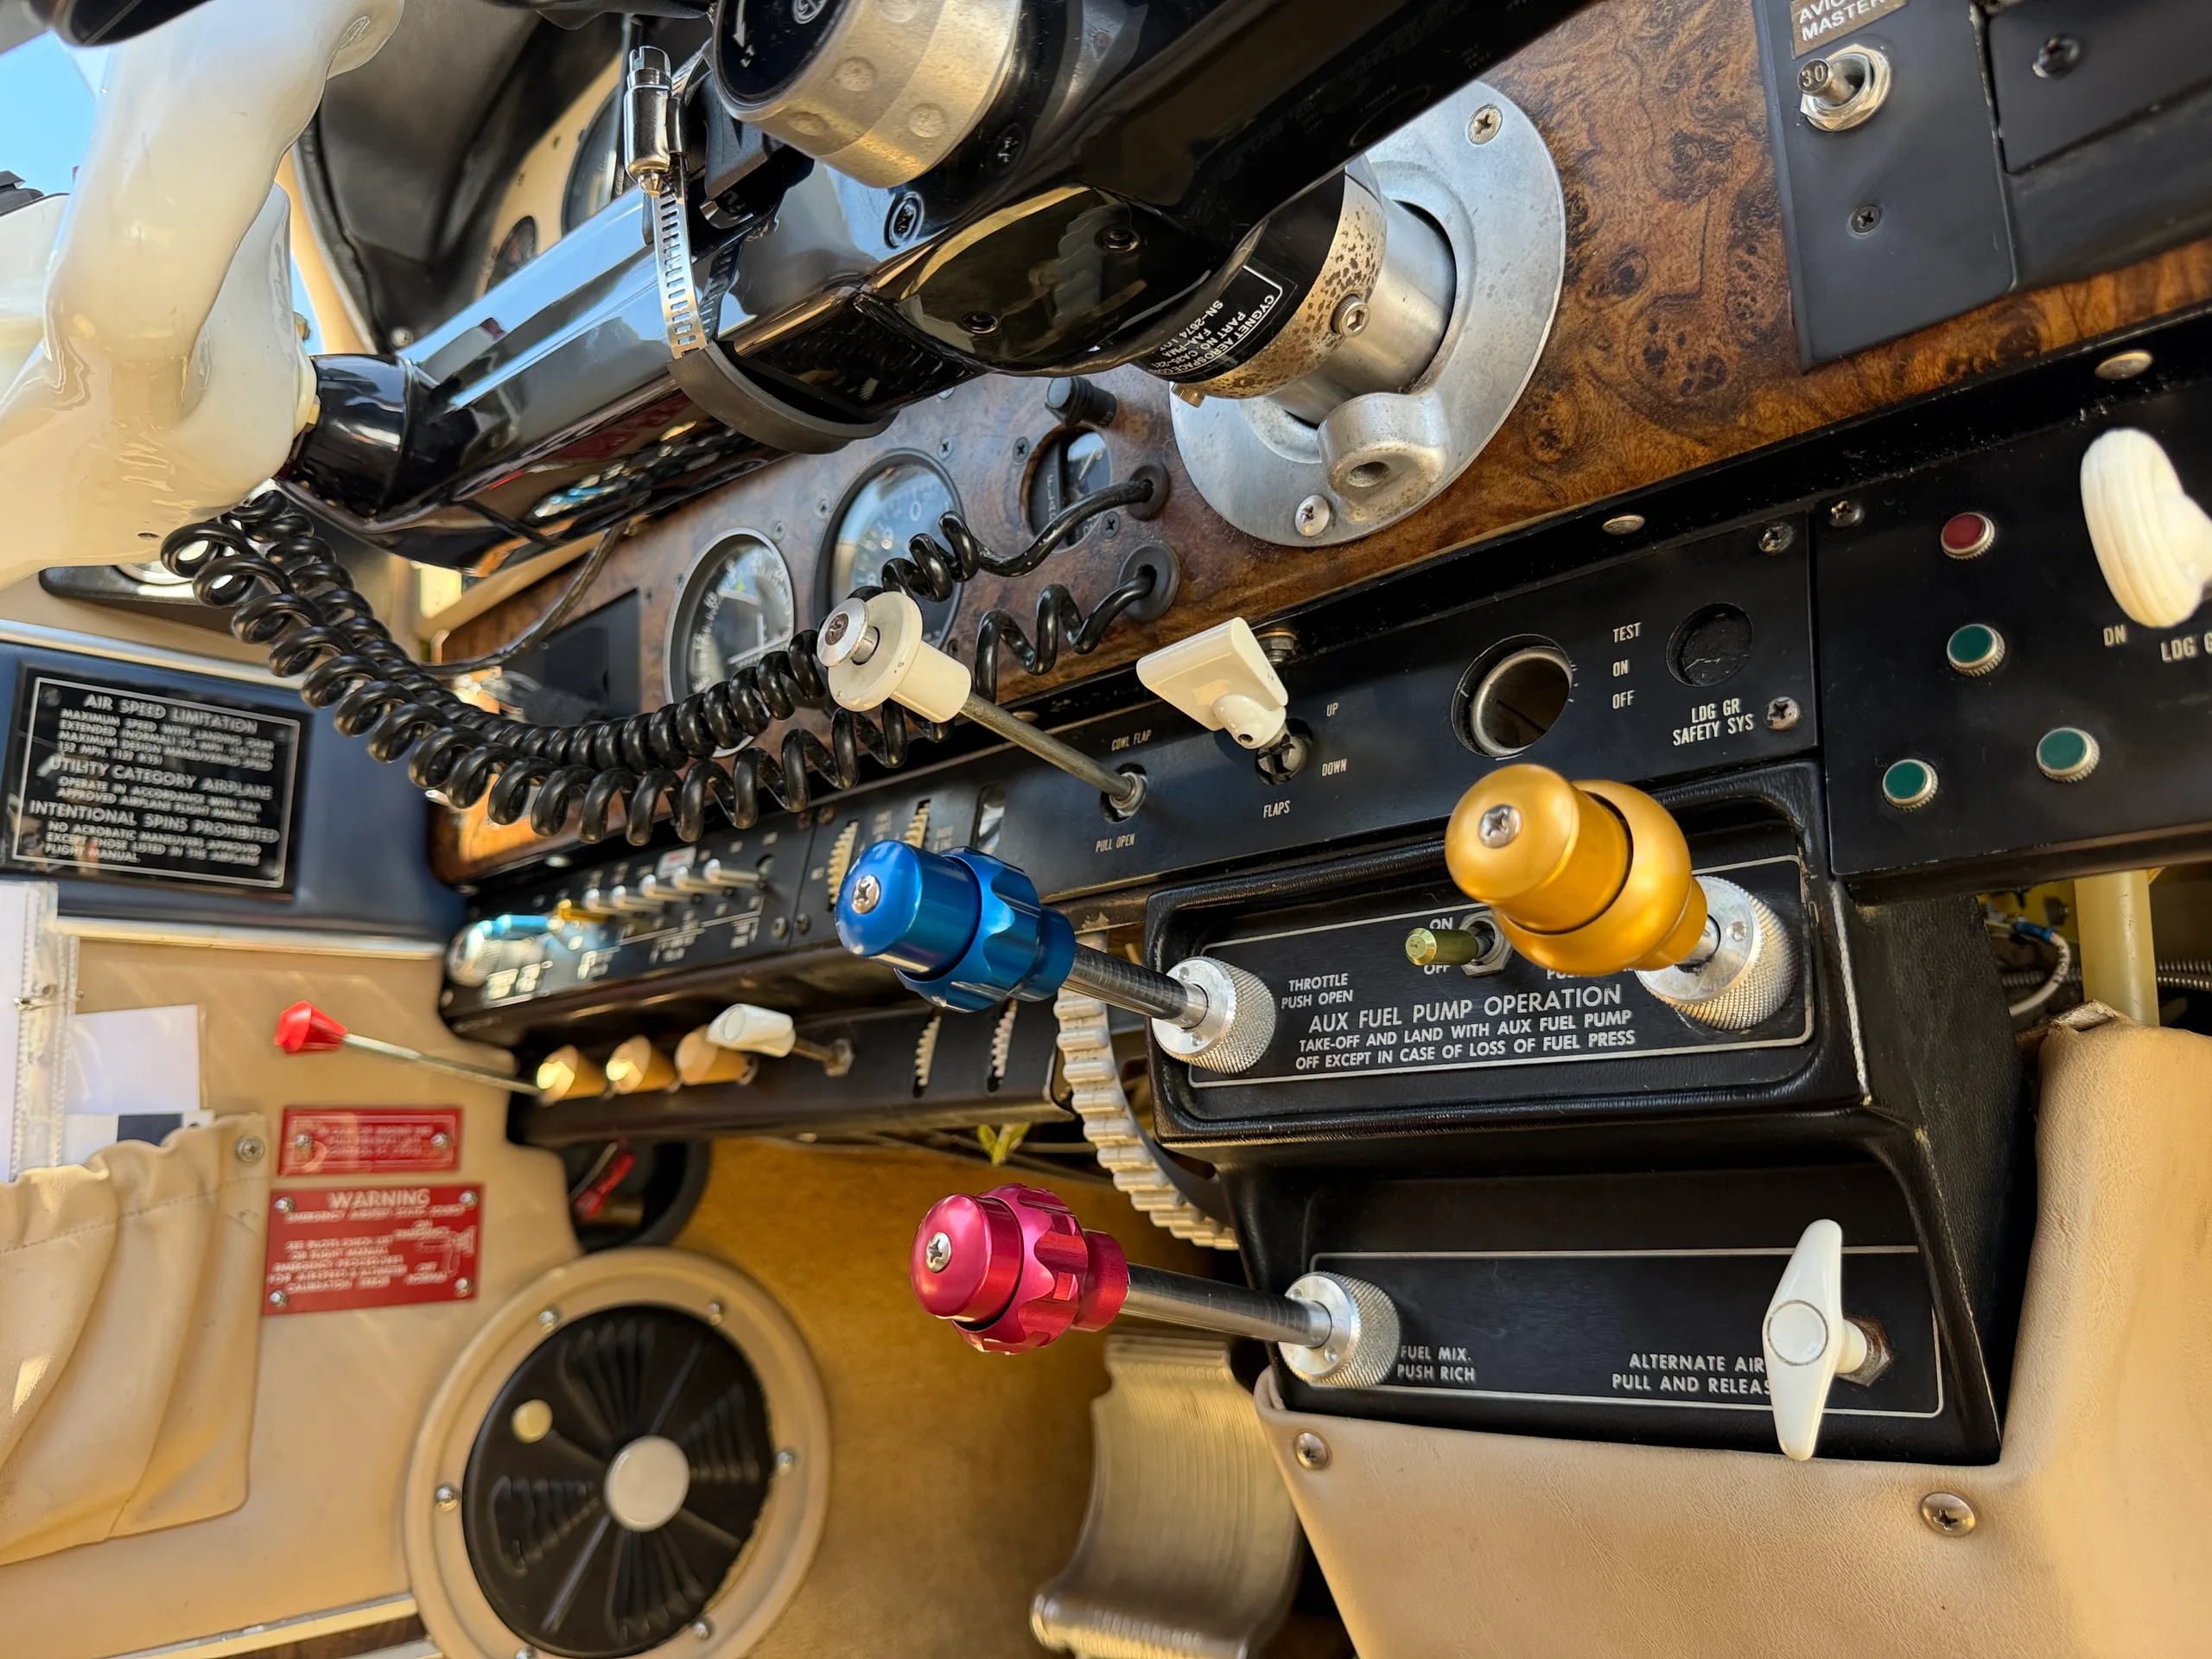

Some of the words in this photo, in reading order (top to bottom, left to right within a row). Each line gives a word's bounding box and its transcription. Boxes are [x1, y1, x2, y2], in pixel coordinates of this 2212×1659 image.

[1802, 64, 1824, 87] 30
[1179, 300, 1224, 338] SN-2674
[1217, 311, 1246, 339] PART
[1234, 295, 1274, 340] CYGNET
[1161, 328, 1211, 357] FAA-PMA
[1197, 337, 1218, 350] NO.
[1172, 337, 1234, 372] AEROSPACE
[1612, 622, 1641, 643] TEST
[2103, 624, 2126, 647] DN
[2160, 636, 2196, 663] LDG
[1612, 659, 1629, 677] ON
[1326, 702, 1338, 717] UP
[1612, 690, 1635, 709] OFF
[1691, 702, 1717, 723] LDG
[1722, 697, 1741, 715] GR
[60, 708, 120, 727] MAXIMUM
[83, 694, 113, 711] AIR
[118, 698, 166, 720] SPEED
[169, 707, 258, 734] LIMITATION
[57, 730, 118, 747] MAXIMUM
[59, 719, 117, 737] EXTENDED
[1672, 721, 1720, 746] SAFETY
[1727, 713, 1755, 734] SYS
[1111, 736, 1129, 751] COWL
[1134, 729, 1152, 745] FLAP
[50, 755, 111, 778] UTILITY
[111, 764, 198, 789] CATEGORY
[198, 777, 274, 801] AIRPLANE
[1321, 759, 1346, 777] DOWN
[57, 775, 109, 792] OPERATE
[55, 787, 117, 804] APPROVED
[1262, 800, 1290, 818] FLAPS
[29, 799, 137, 826] INTENTIONAL
[142, 812, 188, 832] SPINS
[190, 818, 280, 843] PROHIBITED
[47, 820, 69, 833] NO
[71, 823, 137, 841] ACROBATIC
[44, 842, 86, 856] FLIGHT
[45, 831, 87, 846] EXCEPT
[88, 836, 128, 851] THOSE
[1095, 838, 1112, 853] PULL
[1116, 833, 1135, 849] OPEN
[1429, 917, 1453, 930] ON
[1288, 973, 1349, 992] THROTTLE
[1281, 994, 1312, 1009] PUSH
[1318, 989, 1353, 1005] OPEN
[1308, 1012, 1349, 1033] AUX
[1358, 1007, 1402, 1028] FUEL
[1413, 999, 1472, 1023] PUMP
[1484, 983, 1621, 1016] OPERATION
[1299, 1034, 1360, 1052] TAKE-OFF
[1365, 1032, 1397, 1046] AND
[1404, 1027, 1443, 1043] LAND
[1451, 1023, 1490, 1039] WITH
[1497, 1019, 1532, 1035] AUX
[1539, 1015, 1576, 1032] FUEL
[1584, 1009, 1632, 1028] PUMP
[1295, 1056, 1319, 1071] OFF
[1325, 1052, 1371, 1068] EXCEPT
[1377, 1050, 1393, 1064] IN
[1399, 1046, 1436, 1063] CASE
[1441, 1044, 1463, 1059] OF
[1469, 1039, 1505, 1057] LOSS
[1513, 1038, 1536, 1053] OF
[1542, 1034, 1580, 1051] FUEL
[1588, 1029, 1636, 1048] PRESS
[327, 1188, 430, 1209] WARNING
[1401, 1344, 1432, 1360] FUEL
[1438, 1346, 1471, 1362] MIX.
[1629, 1353, 1726, 1372] ALTERNATE
[1734, 1356, 1764, 1373] AIR
[1397, 1363, 1434, 1380] PUSH
[1440, 1366, 1476, 1382] RICH
[1611, 1373, 1651, 1391] PULL
[1660, 1376, 1700, 1392] AND
[1708, 1377, 1770, 1395] RELEAS
